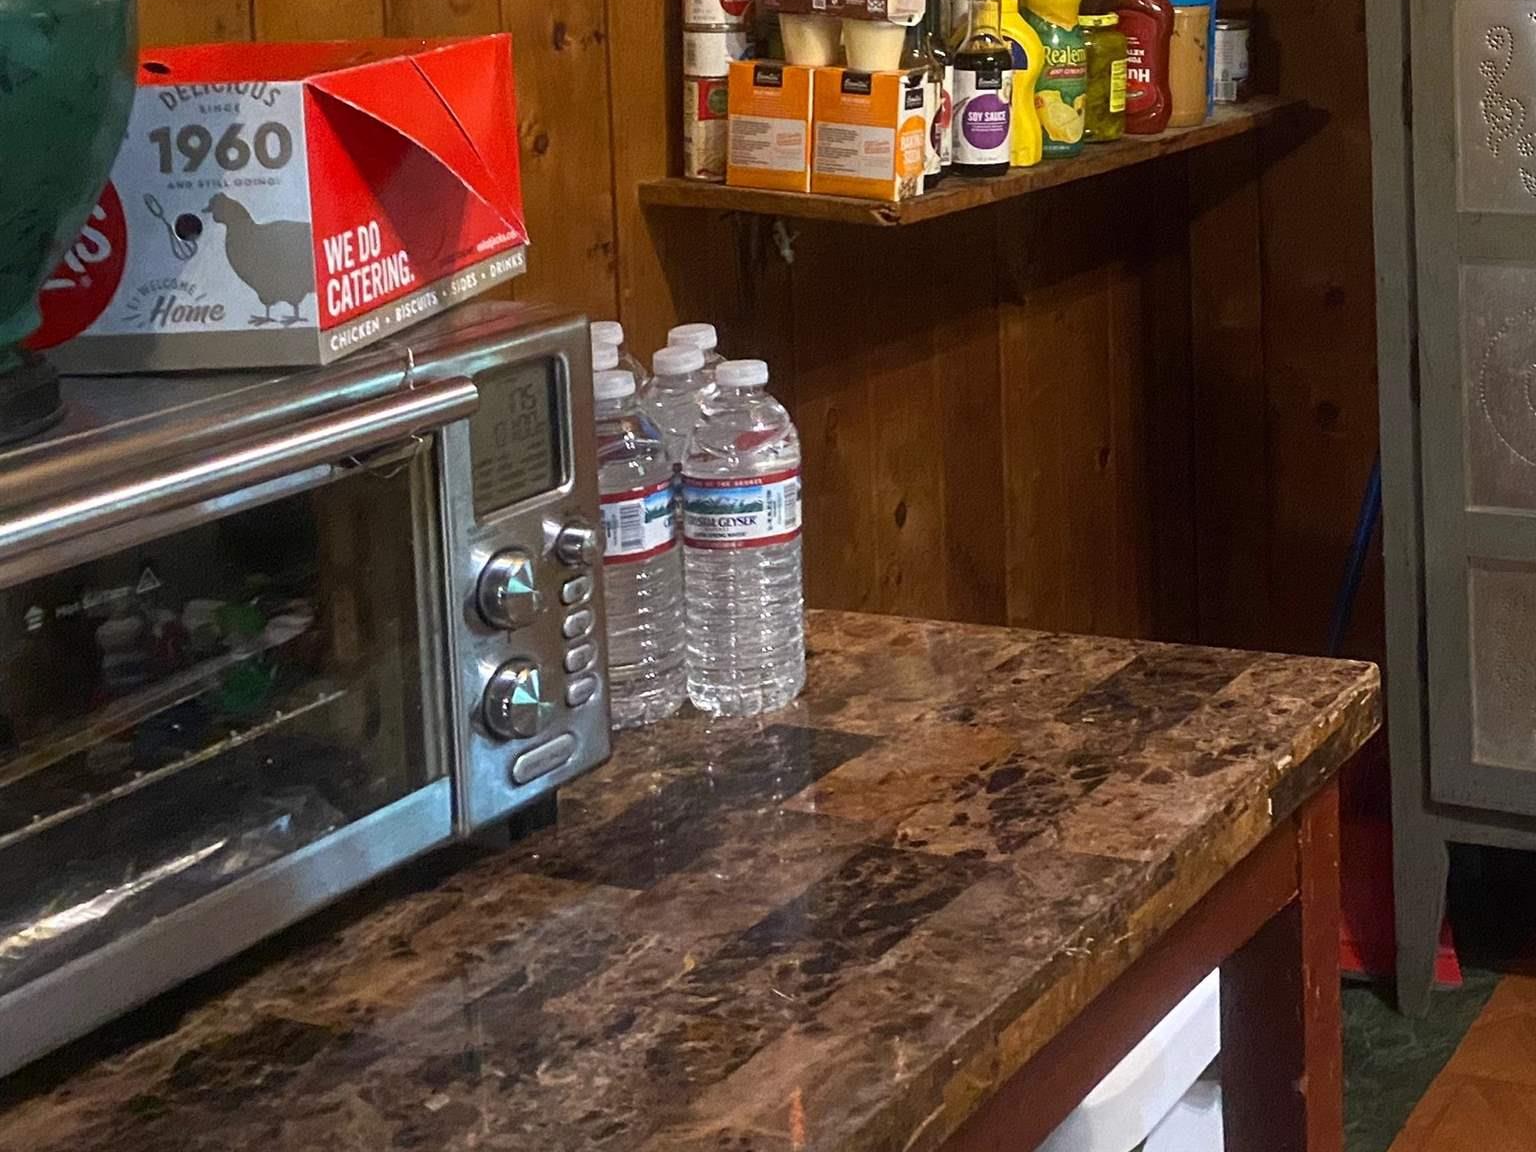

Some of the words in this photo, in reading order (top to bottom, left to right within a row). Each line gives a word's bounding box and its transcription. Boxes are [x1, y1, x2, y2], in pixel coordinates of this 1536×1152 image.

[199, 102, 241, 115] SINCE
[967, 111, 982, 122] SOY
[984, 110, 1007, 122] SAUCE
[148, 120, 293, 175] 1960
[167, 180, 193, 190] AND
[198, 179, 229, 189] STILL
[323, 230, 356, 275] WE
[357, 220, 382, 264] DO
[138, 277, 197, 297] WELCOME
[326, 250, 416, 318] CATERING.
[150, 294, 227, 327] Home
[330, 316, 381, 352] CHICKEN
[395, 291, 439, 323] BISCUITS
[450, 272, 479, 296] SIDES
[489, 252, 525, 279] DRINKS
